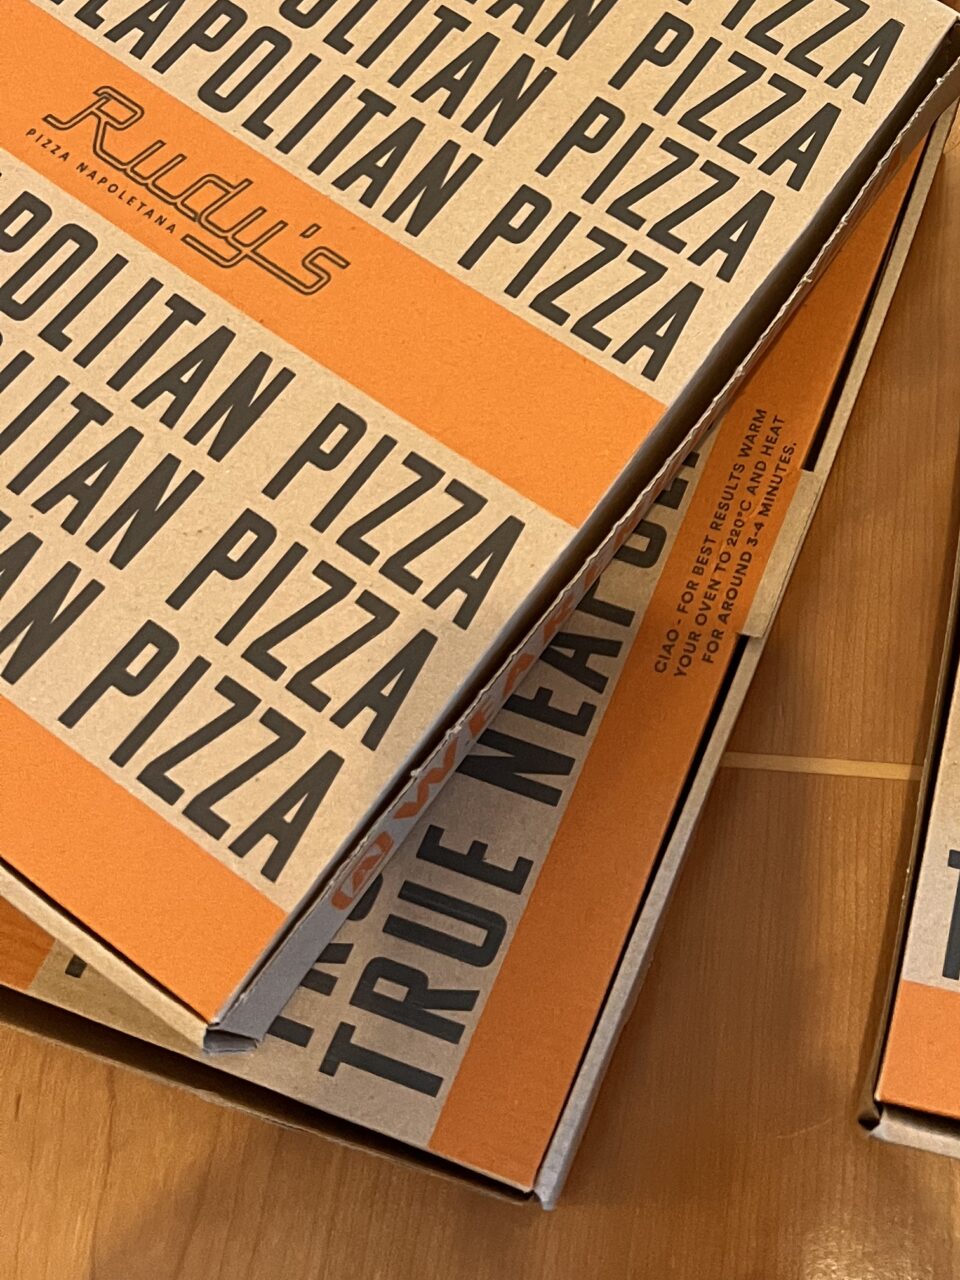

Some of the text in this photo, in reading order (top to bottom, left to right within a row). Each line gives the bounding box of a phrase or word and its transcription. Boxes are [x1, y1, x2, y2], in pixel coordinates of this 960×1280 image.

[25, 127, 177, 235] PIZZA NAPOLETANA
[41, 85, 351, 296] Rudy's
[536, 96, 775, 284] PIZZA
[608, 11, 842, 192] PIZZA
[457, 183, 705, 382] PIZZA
[261, 402, 527, 632] PIZZA
[653, 627, 680, 674] CIAO
[676, 579, 699, 614] FOR
[692, 533, 717, 577] BEST
[709, 463, 746, 532] RESULTS
[736, 407, 768, 460] WARM
[673, 630, 702, 679] YOUR
[695, 577, 722, 627] OVEN
[714, 550, 732, 577] TO
[748, 459, 768, 496] AND
[764, 414, 786, 457] HEAT
[701, 628, 725, 665] FOR
[718, 550, 753, 627] AROUND
[746, 521, 765, 548] 3-4
[164, 507, 439, 752] PIZZA
[57, 618, 346, 883] PIZZA
[318, 823, 535, 1098] TRUE
